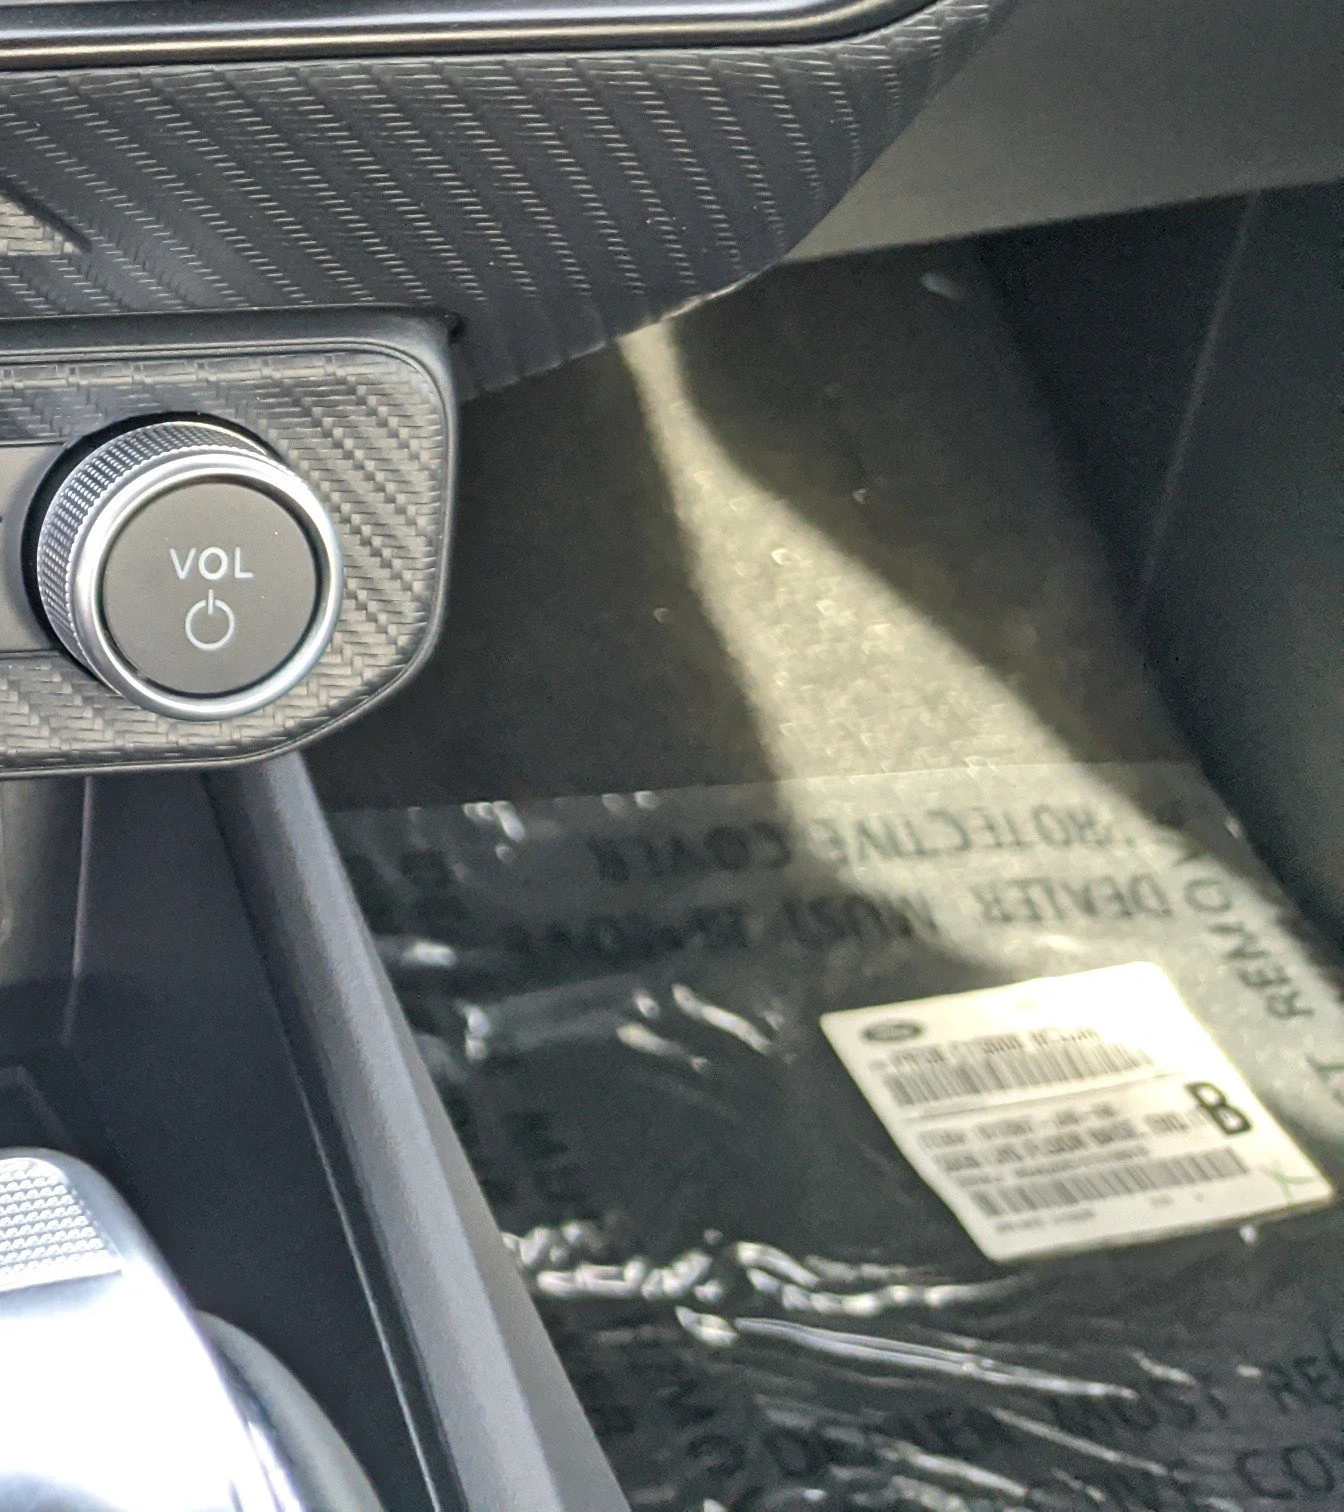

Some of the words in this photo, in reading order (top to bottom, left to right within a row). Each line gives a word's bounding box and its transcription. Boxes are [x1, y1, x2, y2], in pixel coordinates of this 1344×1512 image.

[170, 548, 254, 581] VOL
[814, 804, 1135, 868] ROTECTIVE
[976, 872, 1174, 925] DEALER
[1184, 1080, 1252, 1136] B
